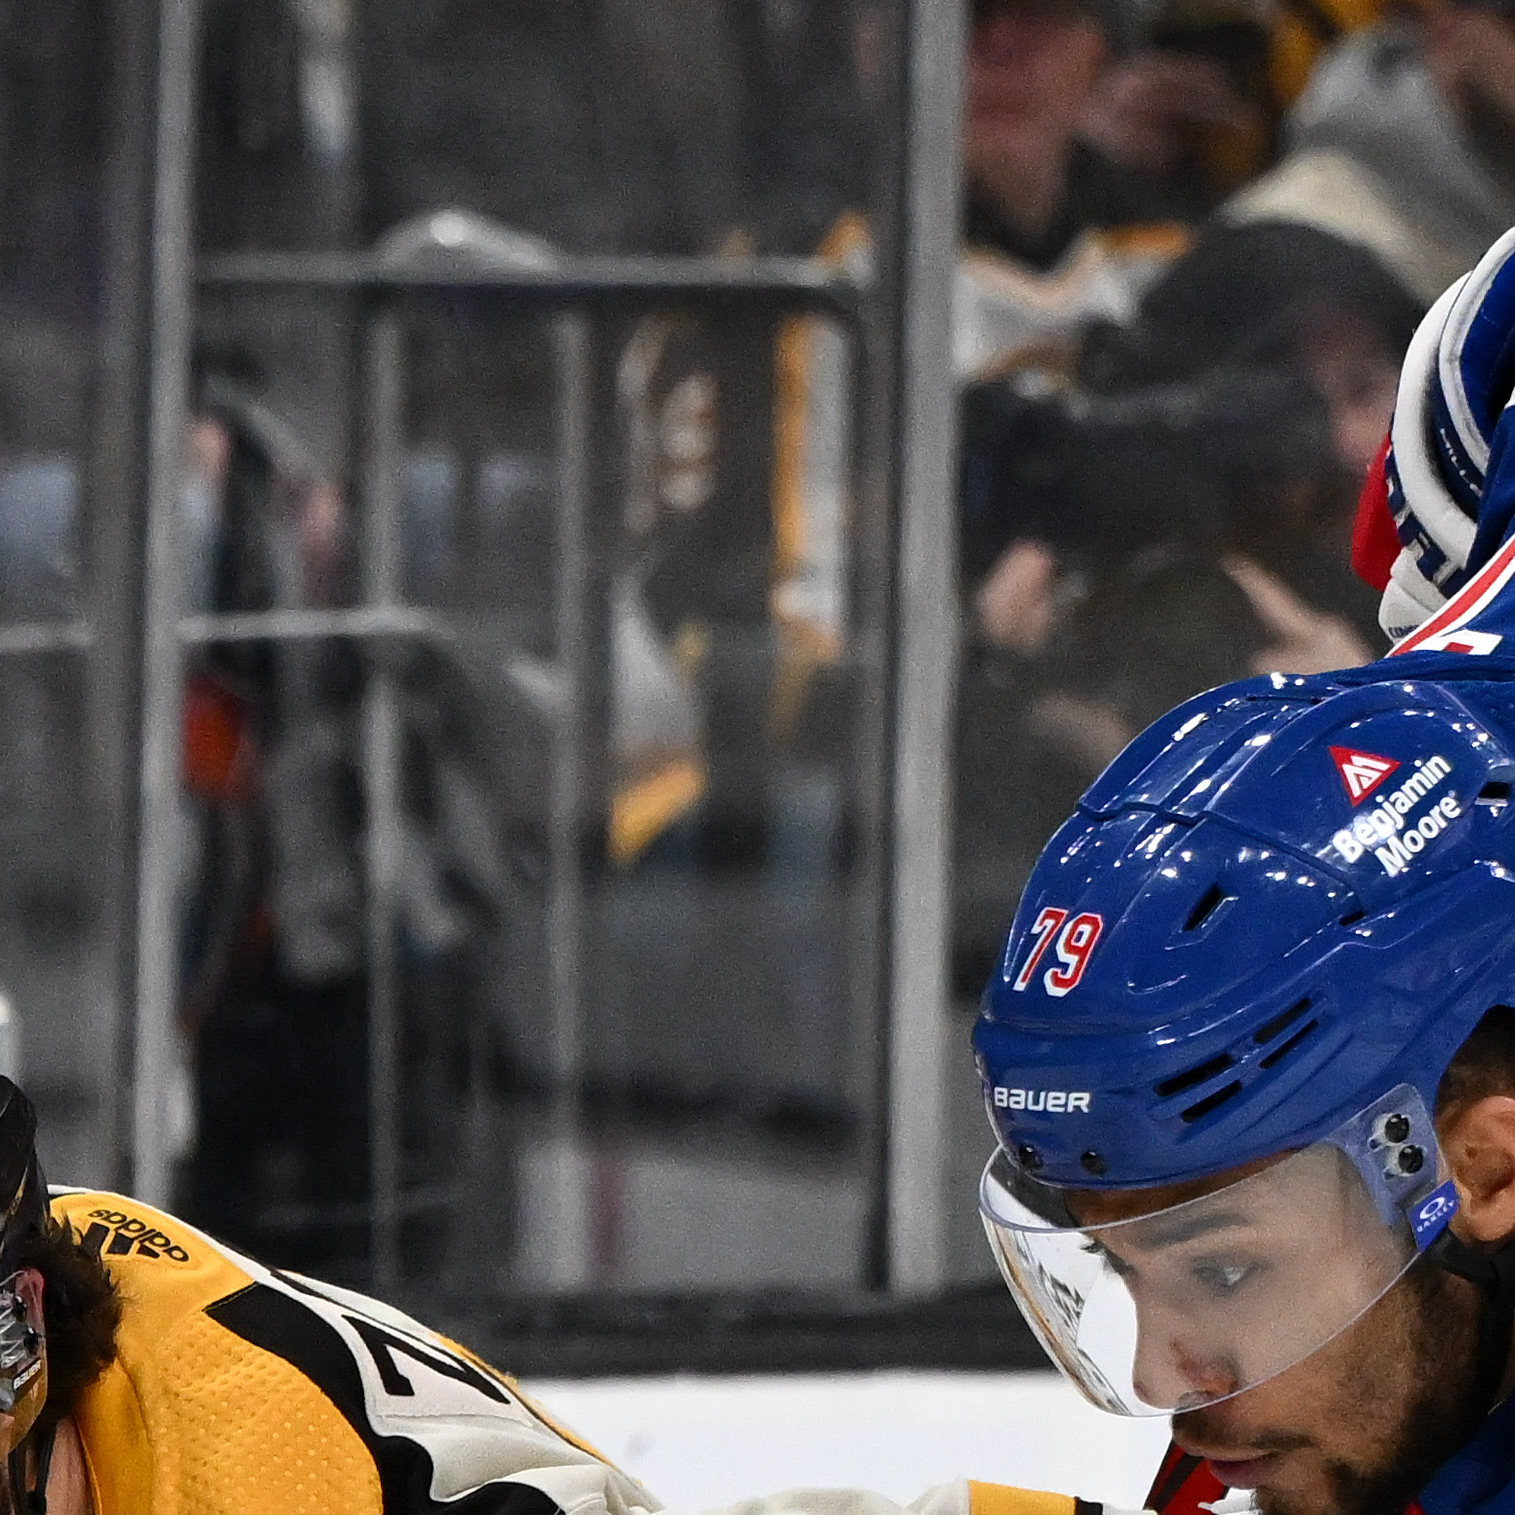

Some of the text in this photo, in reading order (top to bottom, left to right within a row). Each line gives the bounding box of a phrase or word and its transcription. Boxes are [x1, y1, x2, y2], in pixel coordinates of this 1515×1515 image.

[1332, 755, 1451, 863] Benjamin
[1375, 797, 1461, 877] Moore
[1012, 906, 1103, 997] 79
[994, 1086, 1090, 1114] BAUER
[88, 1209, 189, 1262] adidas
